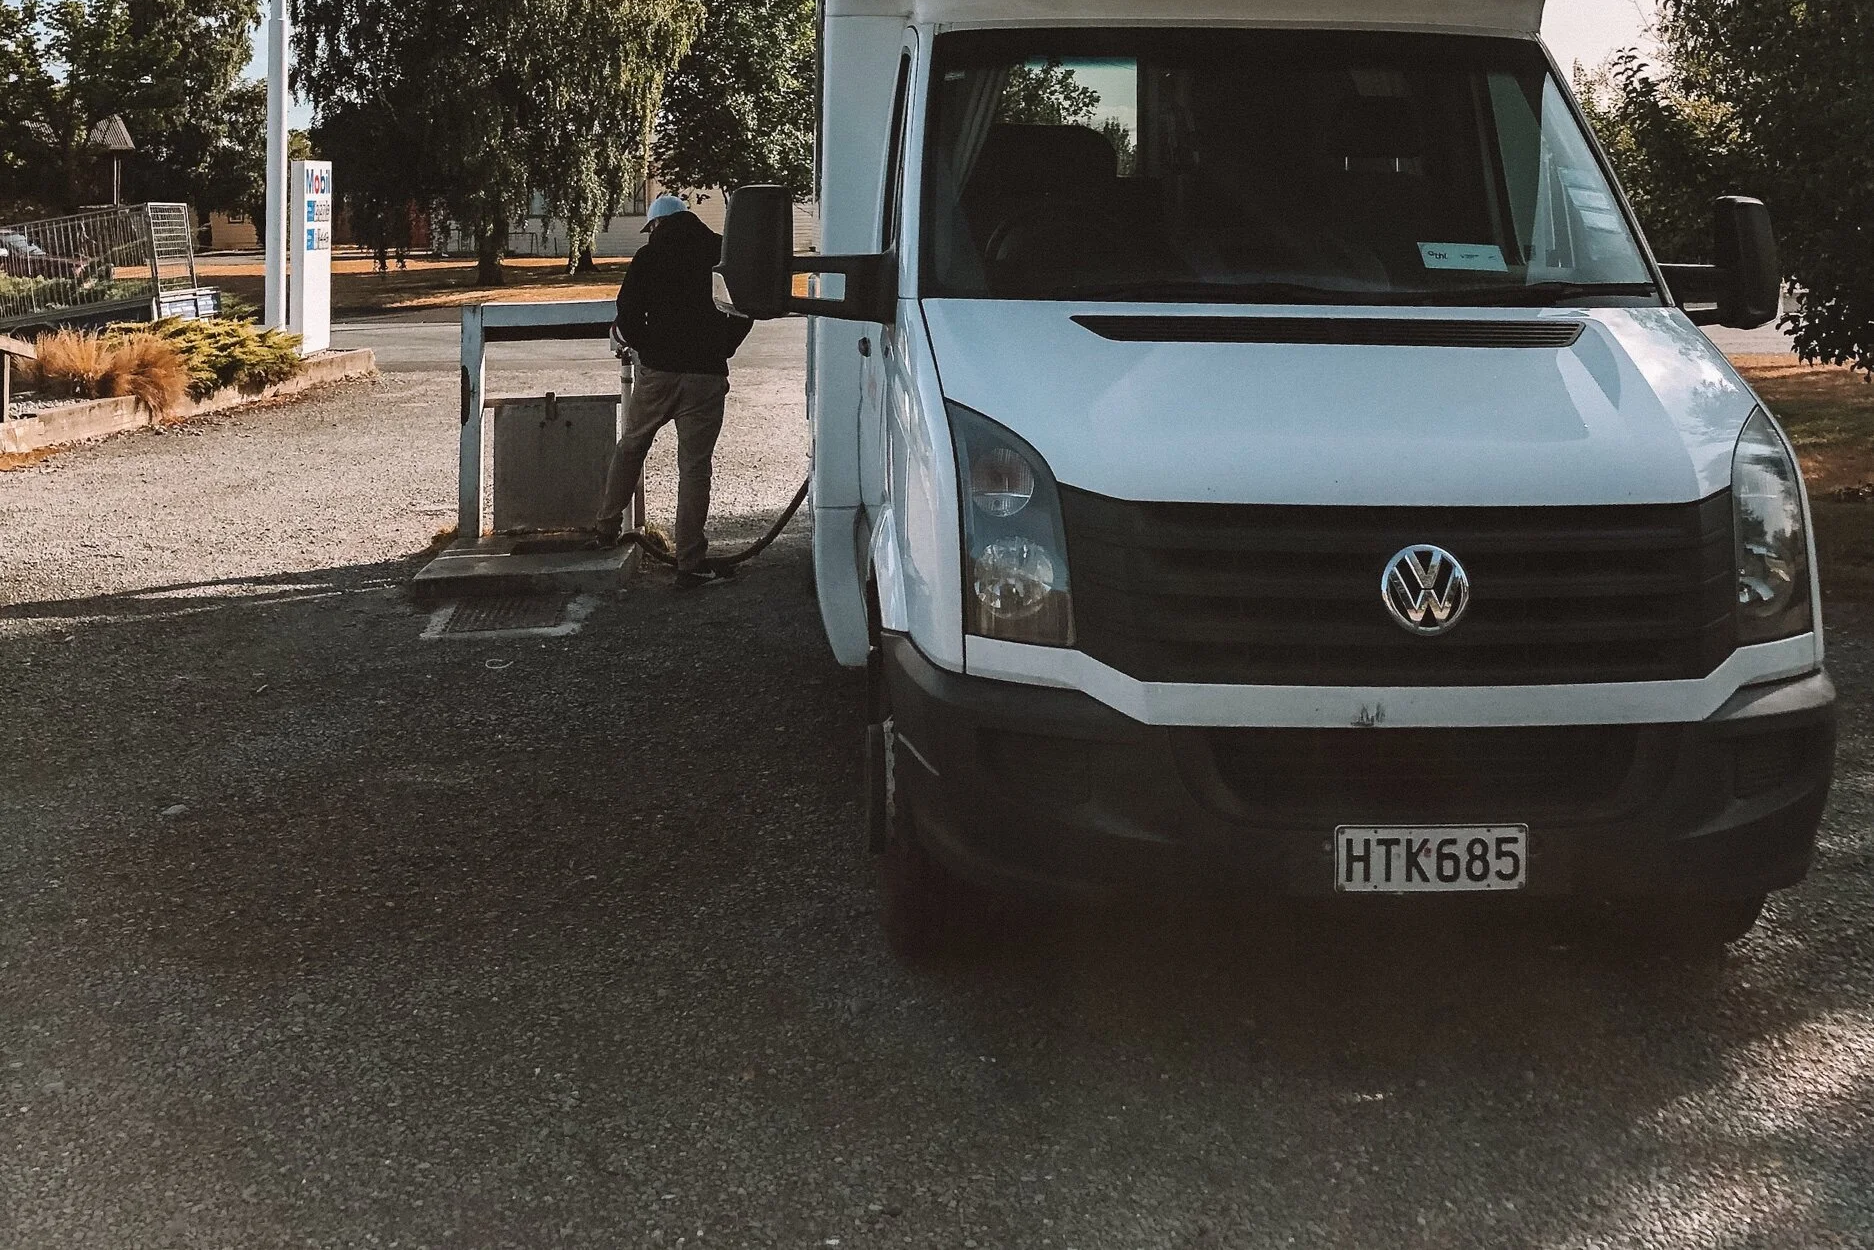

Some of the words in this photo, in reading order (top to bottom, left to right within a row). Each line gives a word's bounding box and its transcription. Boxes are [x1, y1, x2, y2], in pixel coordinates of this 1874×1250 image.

[306, 168, 331, 194] Mobil
[1382, 544, 1469, 636] VW
[1345, 837, 1521, 883] HTK685
